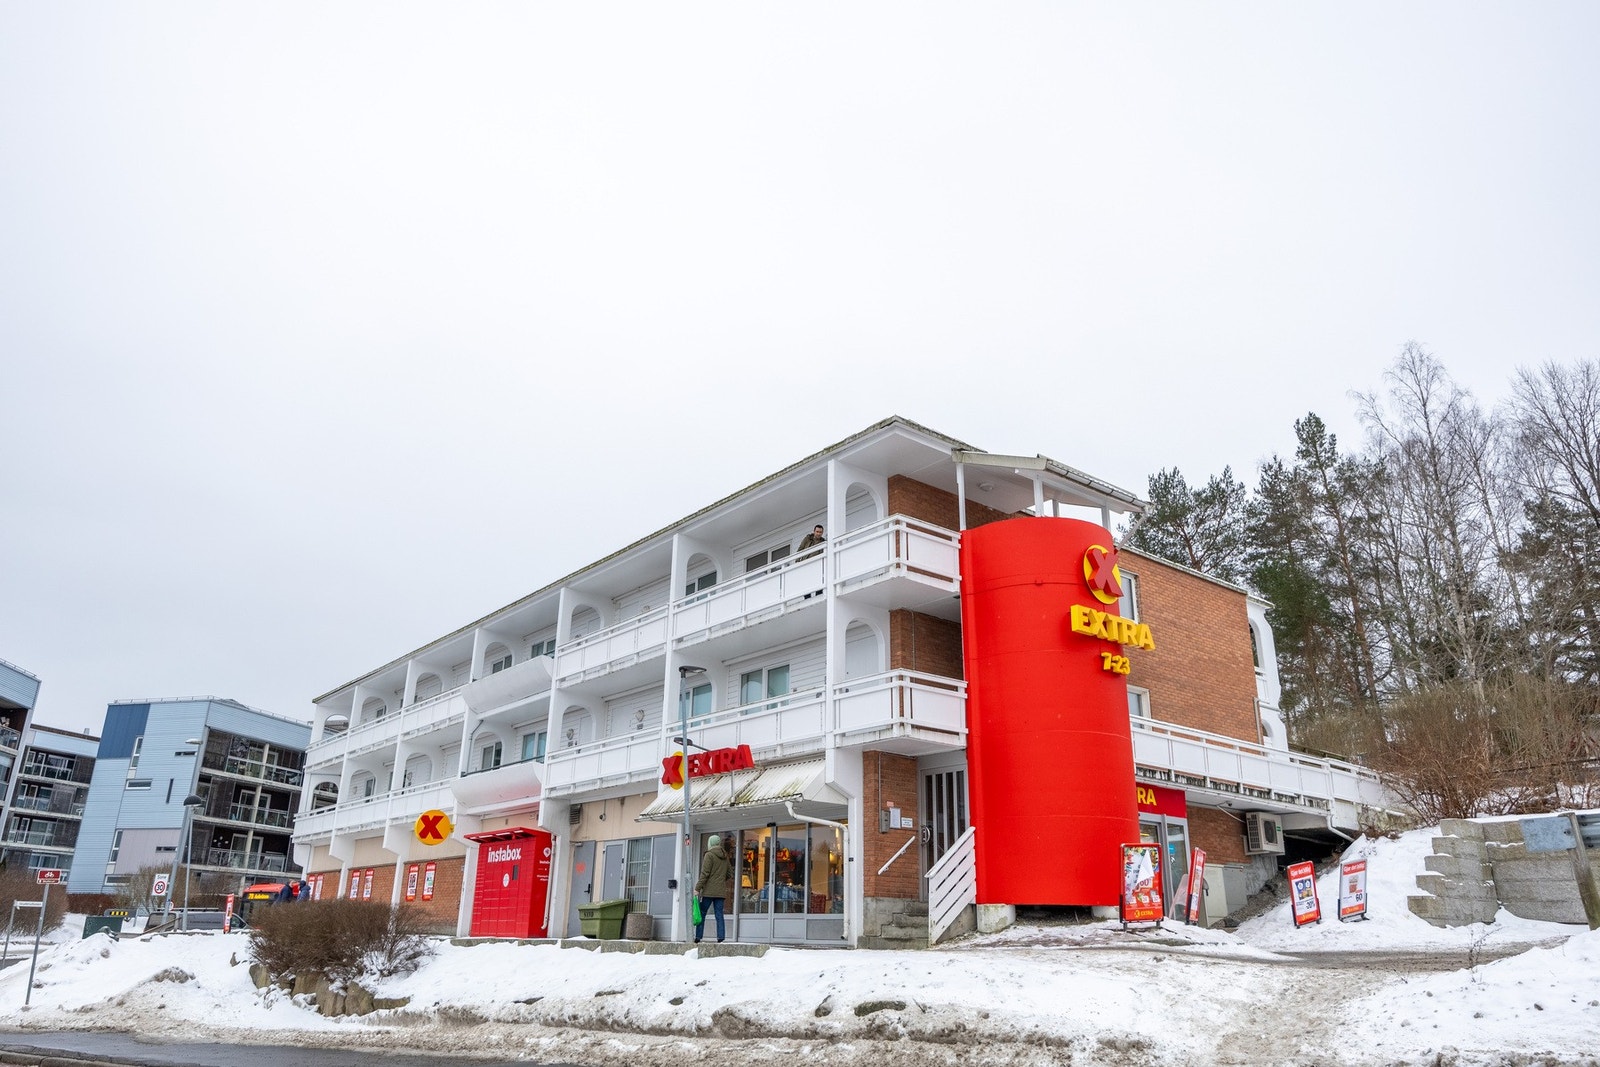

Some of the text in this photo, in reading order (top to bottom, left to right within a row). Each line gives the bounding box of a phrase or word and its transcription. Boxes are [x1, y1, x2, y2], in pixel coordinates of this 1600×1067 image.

[1070, 604, 1156, 651] EXTRA
[1101, 651, 1131, 675] 7-23
[687, 744, 755, 778] EXTRA
[1136, 786, 1157, 806] RA
[487, 845, 522, 863] instabox
